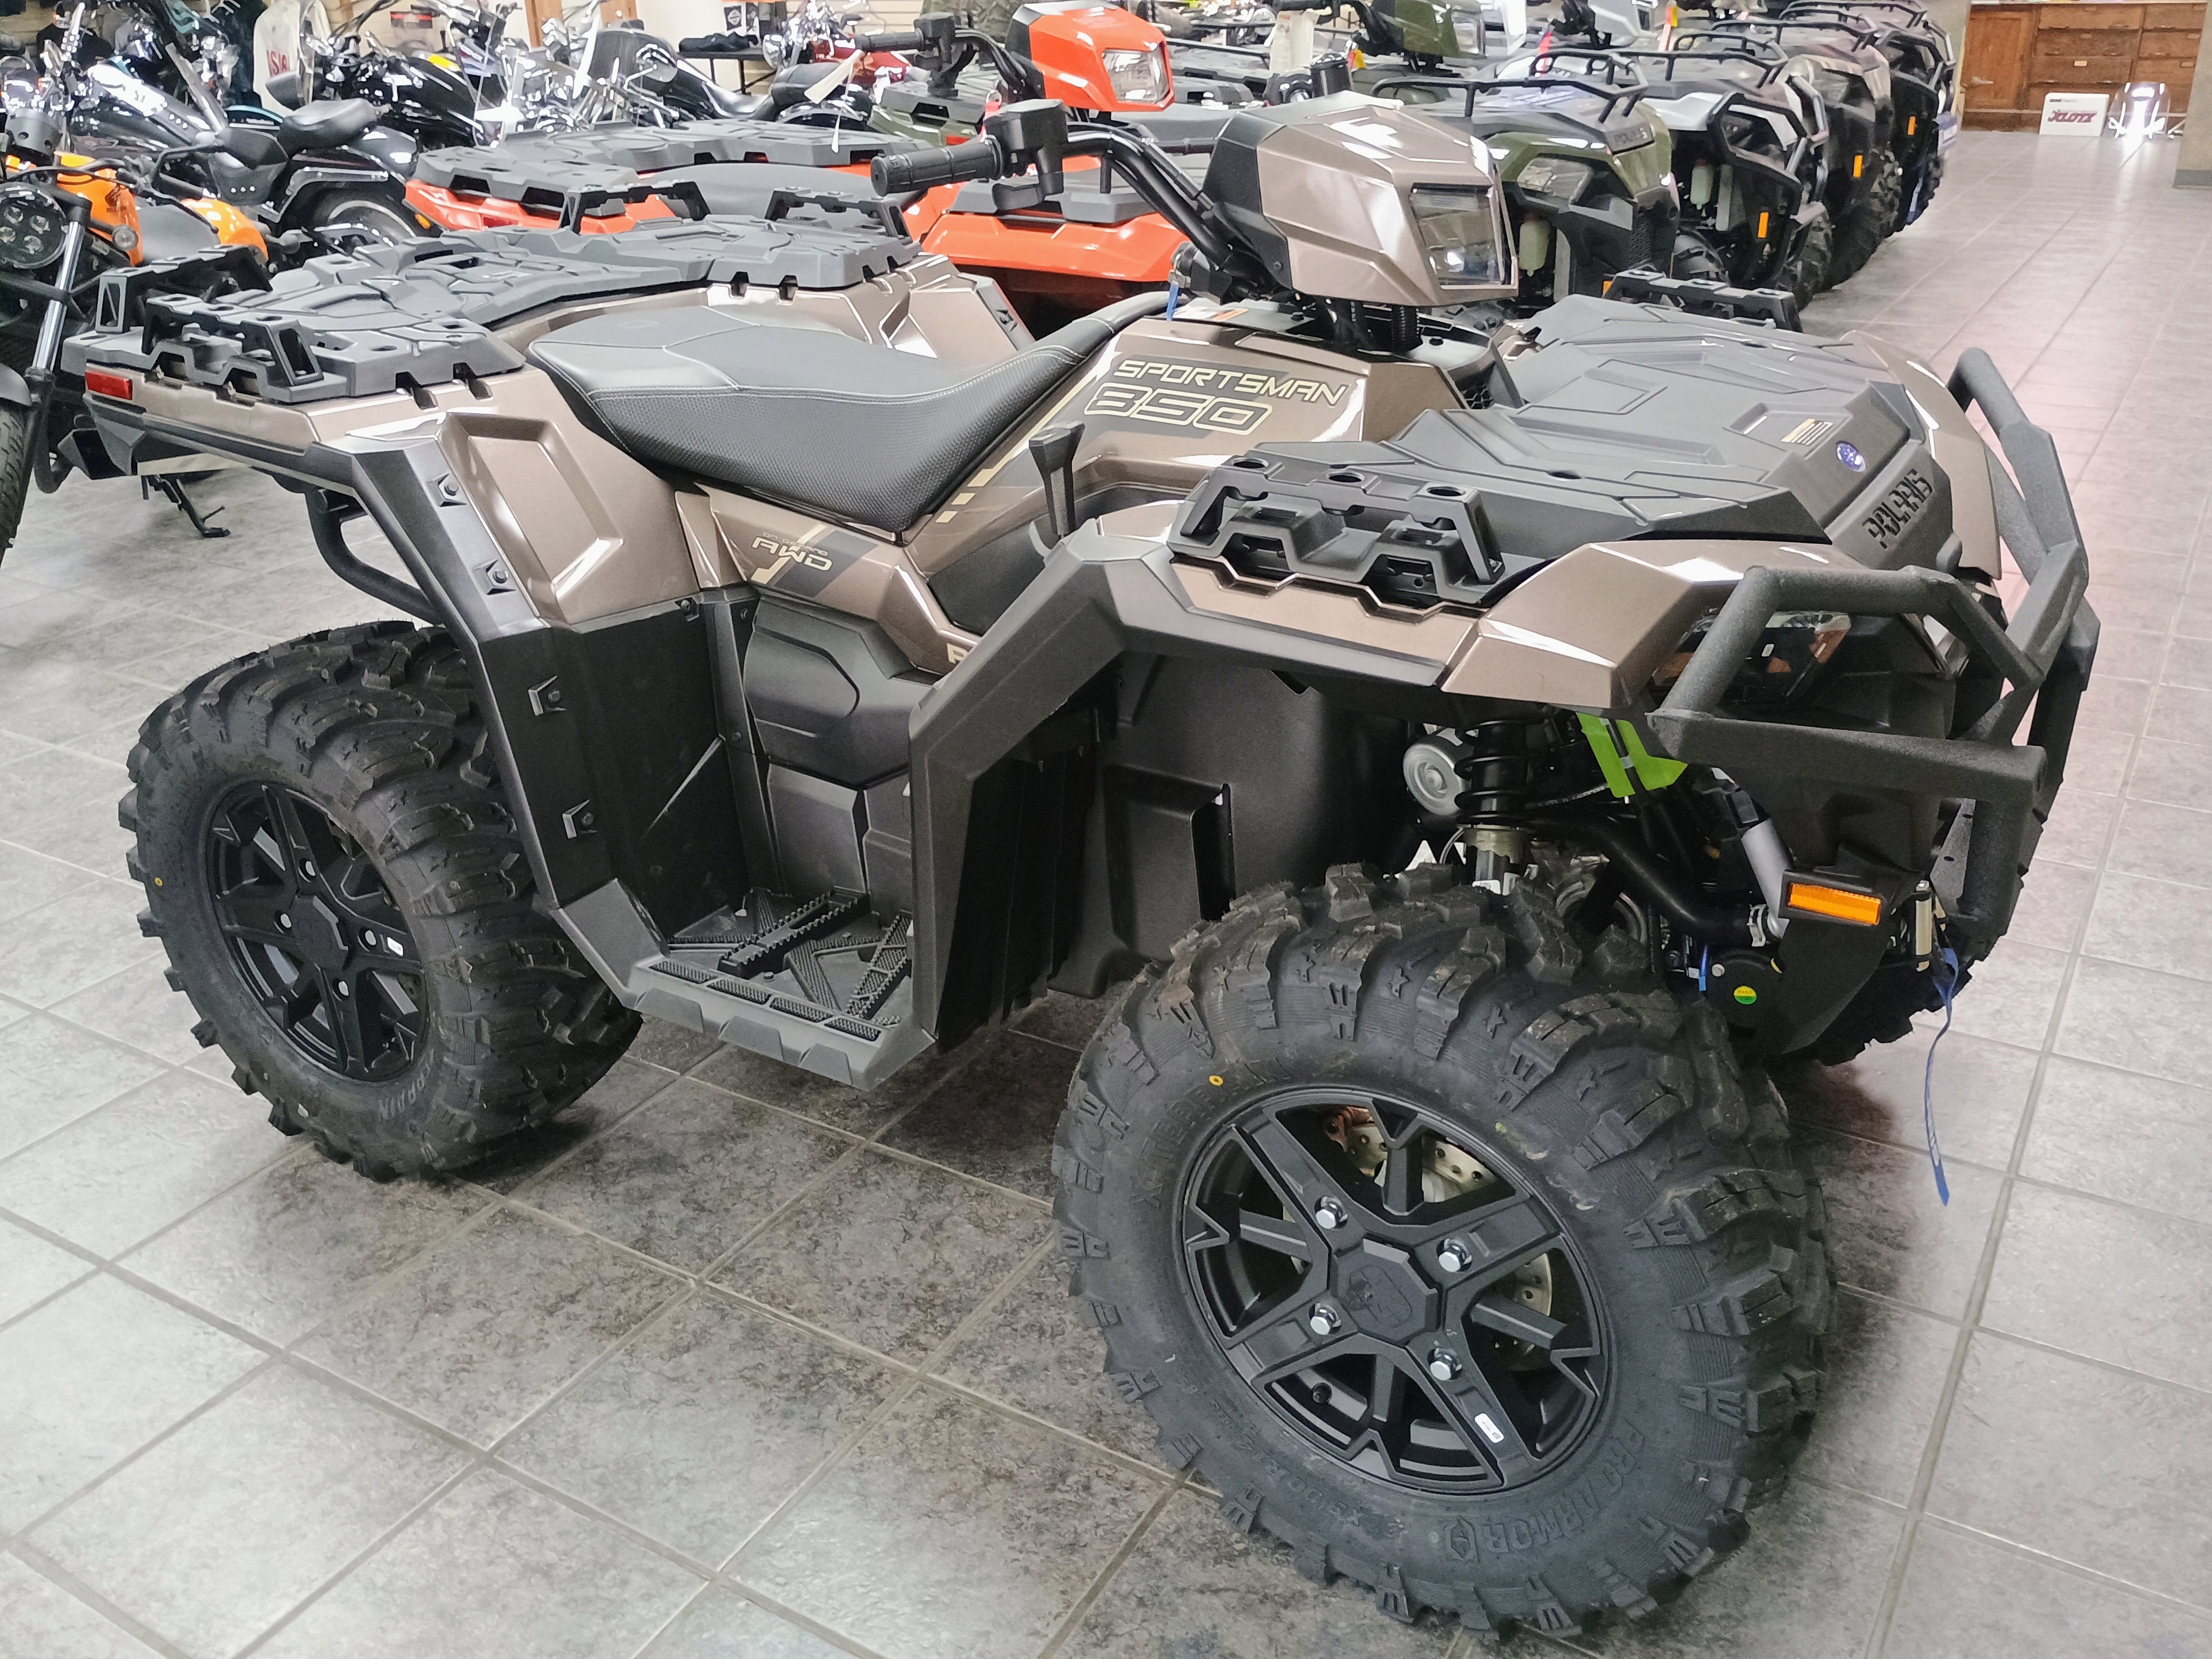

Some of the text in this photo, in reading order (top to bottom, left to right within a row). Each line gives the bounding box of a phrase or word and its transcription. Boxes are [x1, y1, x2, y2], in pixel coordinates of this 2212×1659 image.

[1113, 359, 1350, 406] SPORTSMAN
[1084, 382, 1273, 435] 850
[1863, 468, 1933, 549] POLARIS
[752, 537, 833, 571] AWD
